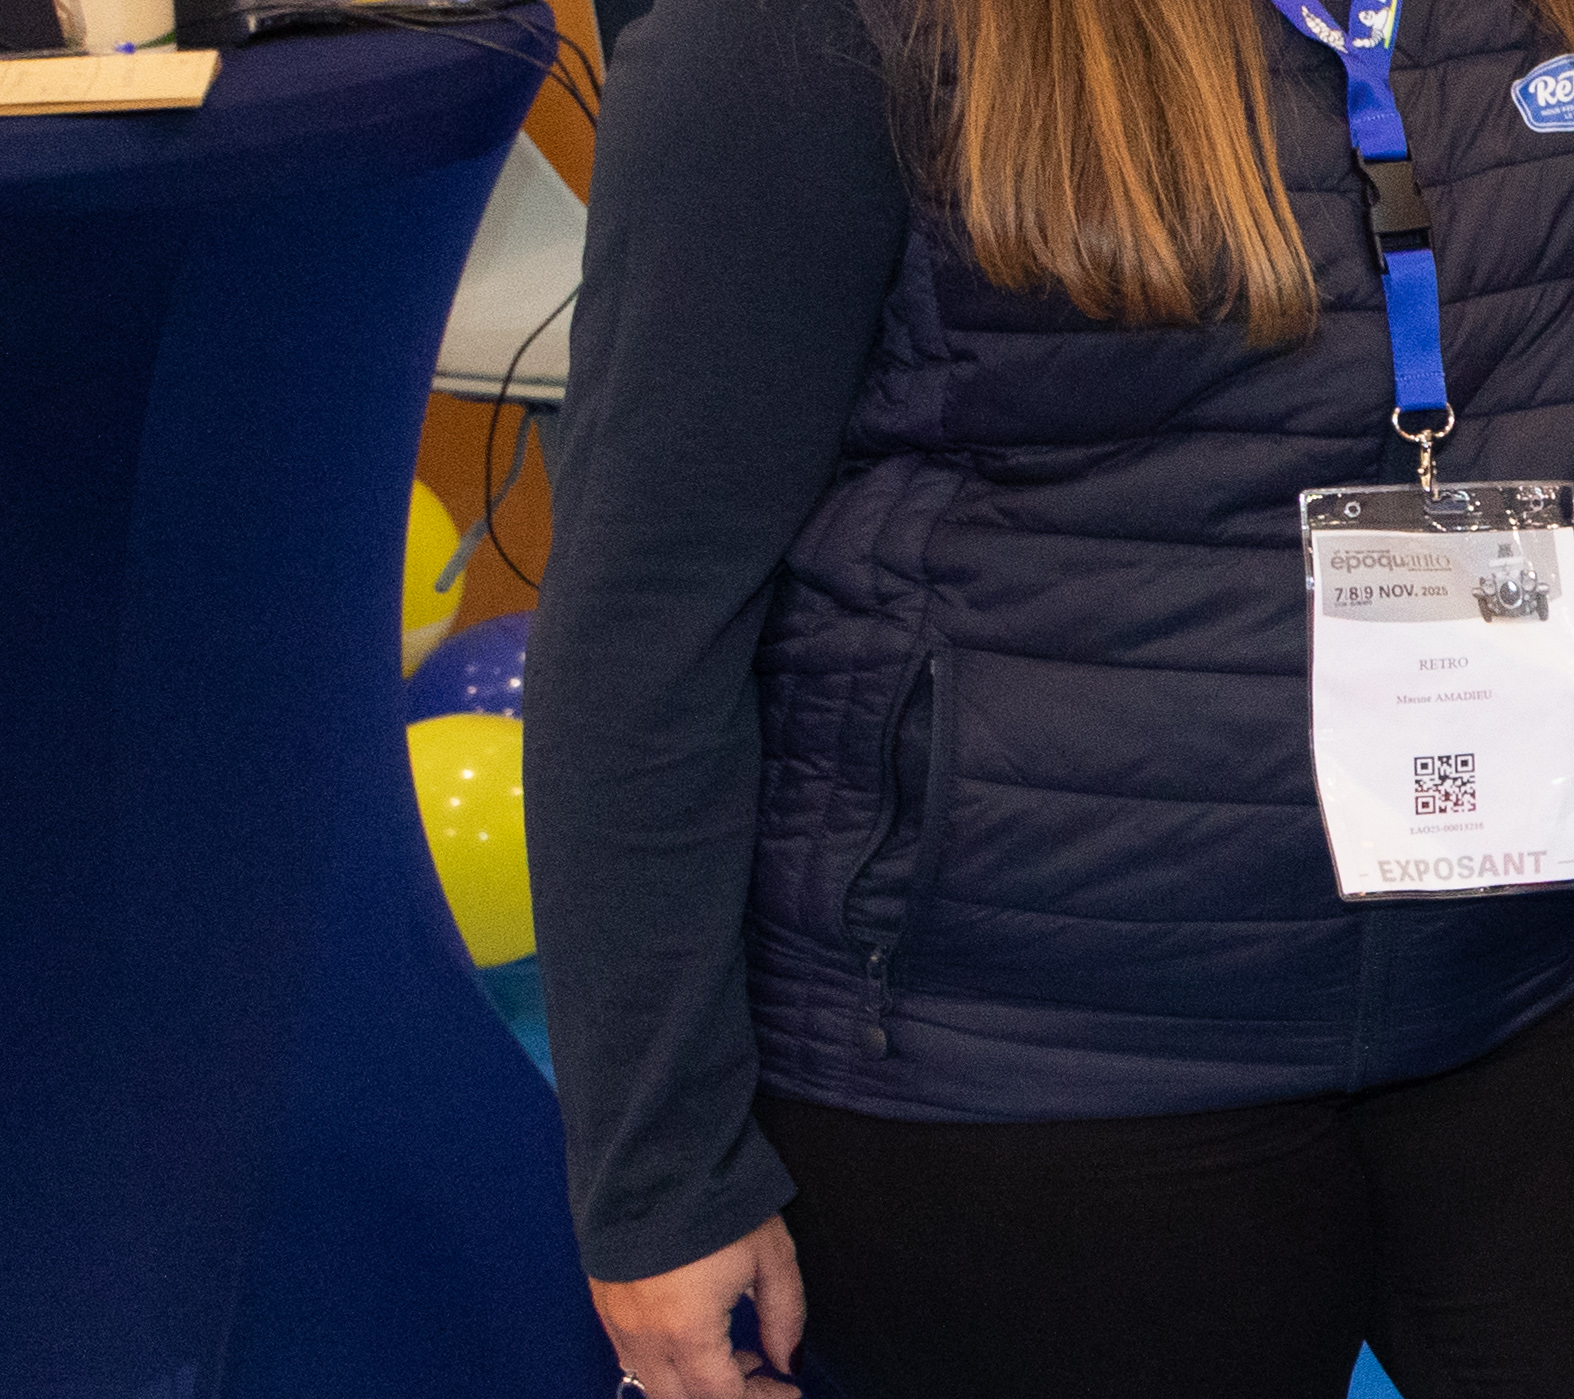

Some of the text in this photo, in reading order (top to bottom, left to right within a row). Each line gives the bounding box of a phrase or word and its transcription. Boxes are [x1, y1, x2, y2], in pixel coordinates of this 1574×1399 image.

[1378, 583, 1418, 599] NOV.
[1421, 585, 1449, 597] 2025
[1419, 656, 1469, 671] RETRO
[1377, 850, 1548, 883] EXPOSANT
